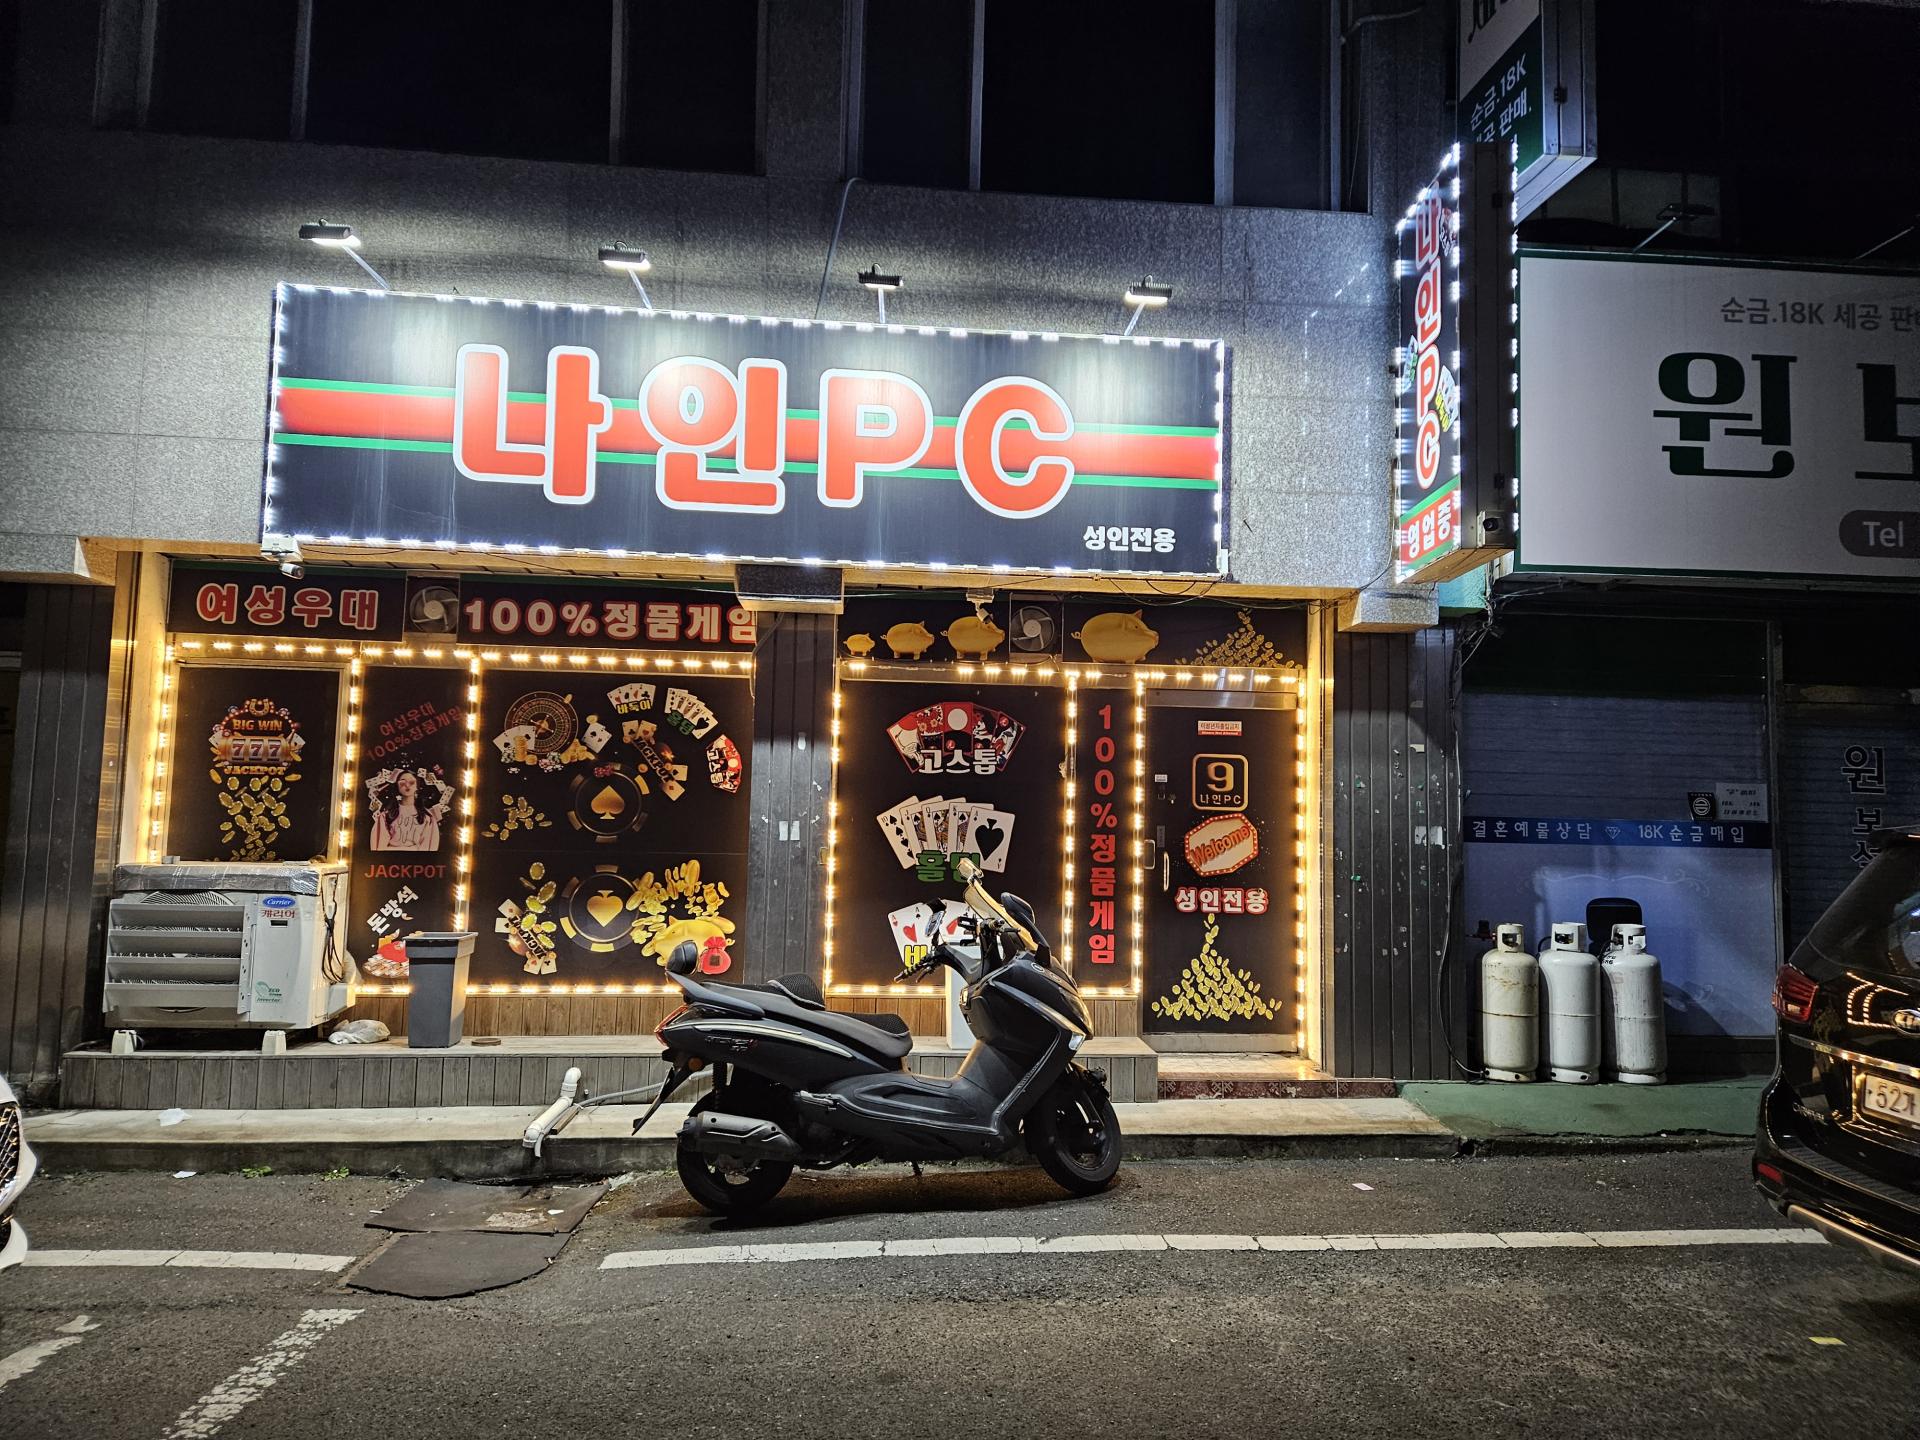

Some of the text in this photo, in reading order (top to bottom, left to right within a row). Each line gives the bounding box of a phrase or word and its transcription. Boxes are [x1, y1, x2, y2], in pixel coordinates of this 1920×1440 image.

[1720, 296, 1824, 325] 순금.18K
[1833, 303, 1882, 331] 세공
[453, 343, 1075, 520] 나인PC
[1083, 525, 1177, 553] 성인전용
[1407, 499, 1452, 560] 영업중
[1862, 521, 1904, 547] Tel
[196, 582, 379, 631] 여성우대
[232, 719, 283, 731] BIG WIN
[380, 702, 436, 736] 여성우대
[223, 765, 287, 775] JACKPOT
[918, 748, 998, 775] 고스톱
[1206, 762, 1235, 793] 9
[1087, 704, 1118, 964] 100%정품게임
[1190, 823, 1251, 867] Welcome
[364, 864, 447, 879] JACKPOT
[261, 908, 296, 919] 캐리어
[267, 898, 292, 906] Carrier
[366, 885, 419, 936] 돈방석
[1175, 886, 1269, 915] 성인전용
